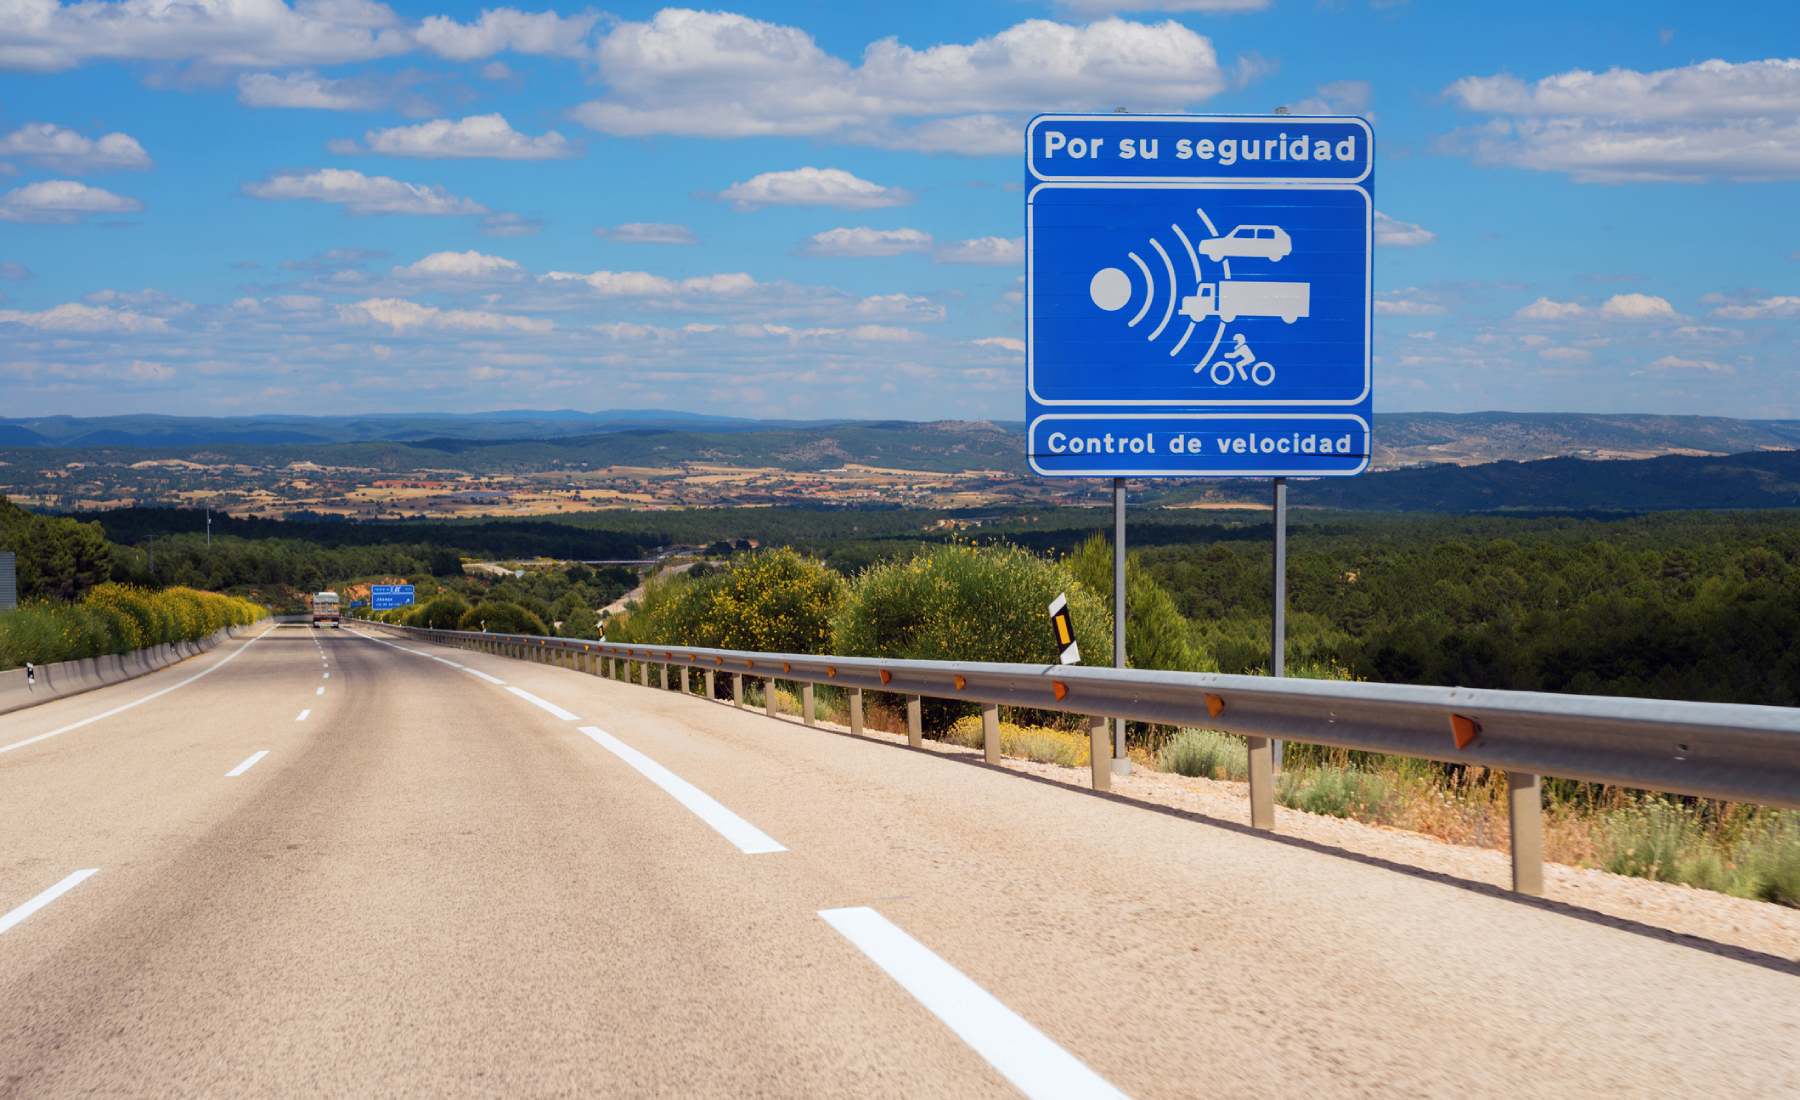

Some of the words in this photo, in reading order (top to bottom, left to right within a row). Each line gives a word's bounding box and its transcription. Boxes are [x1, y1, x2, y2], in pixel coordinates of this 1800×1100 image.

[1045, 131, 1104, 159] Por
[1119, 138, 1159, 160] su
[1175, 132, 1356, 166] seguridad
[1048, 432, 1156, 454] Control
[1169, 434, 1203, 454] de
[1217, 432, 1352, 454] velocidad
